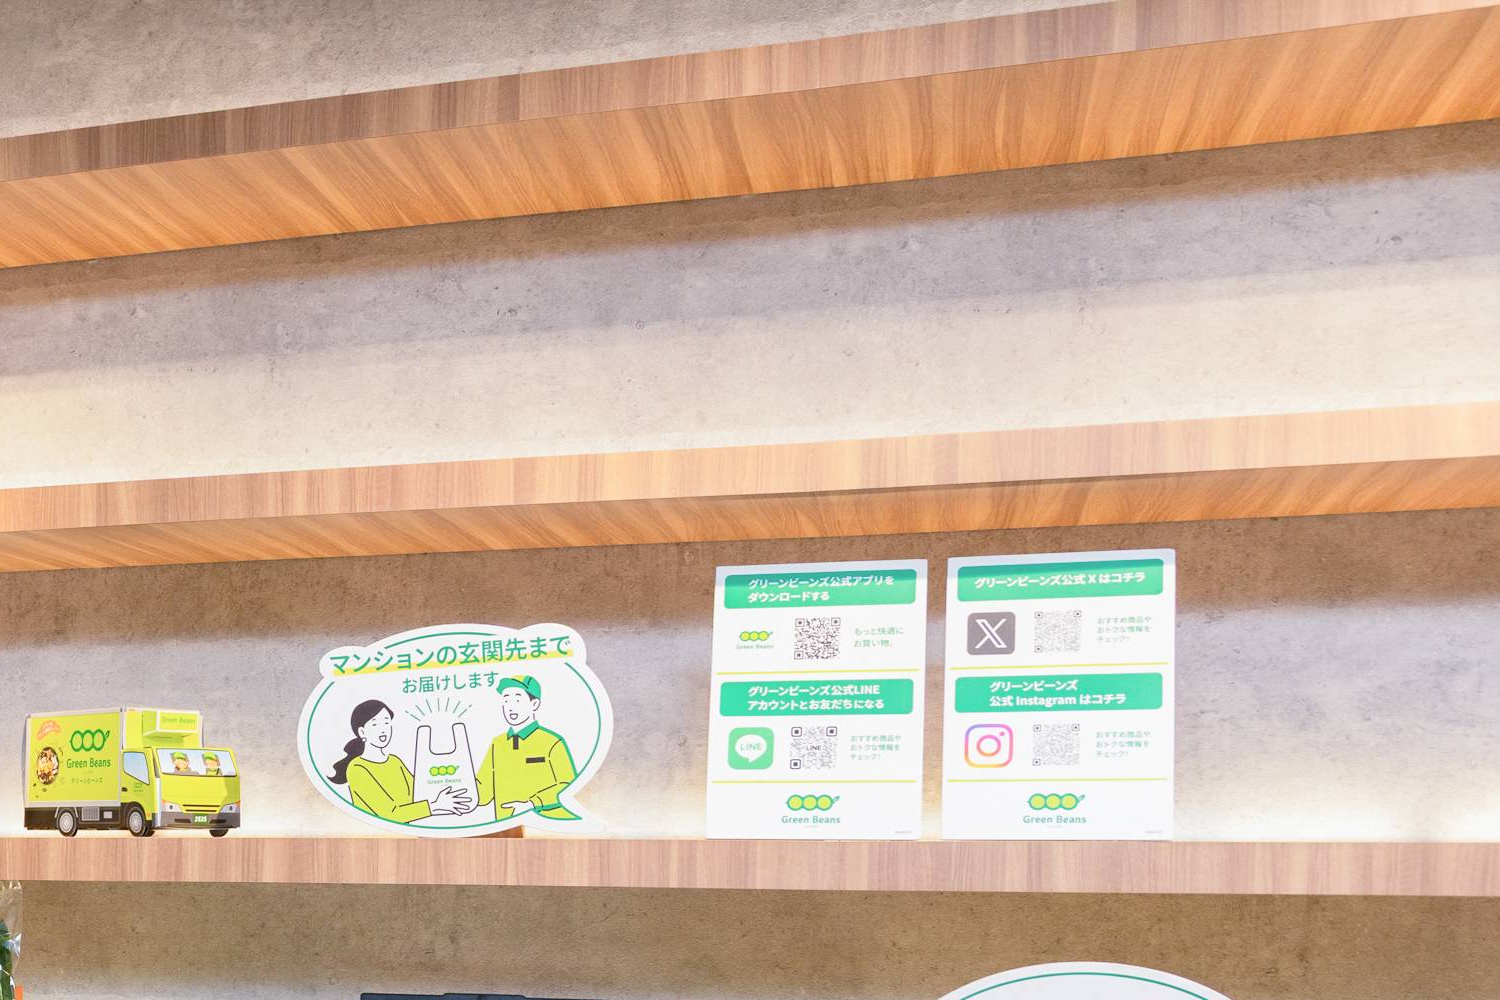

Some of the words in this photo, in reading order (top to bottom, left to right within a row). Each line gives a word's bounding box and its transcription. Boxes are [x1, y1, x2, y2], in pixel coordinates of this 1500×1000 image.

[748, 575, 895, 589] グリーンビーンズ公式アプリを
[748, 591, 830, 603] ダウンロードする
[329, 635, 572, 674] マンションの玄関先まで
[402, 670, 499, 694] お届けします
[989, 680, 1079, 692] グリーンビーンズ
[748, 685, 881, 697] グリーンビーンズ公式LINE
[748, 699, 885, 711] アカウントとお友だちになる
[740, 742, 763, 751] LINE
[66, 758, 88, 768] Green
[90, 758, 111, 768] Beans
[781, 815, 810, 824] Green
[812, 815, 841, 824] Beans
[1023, 815, 1053, 824] Green
[1056, 815, 1087, 824] Beans
